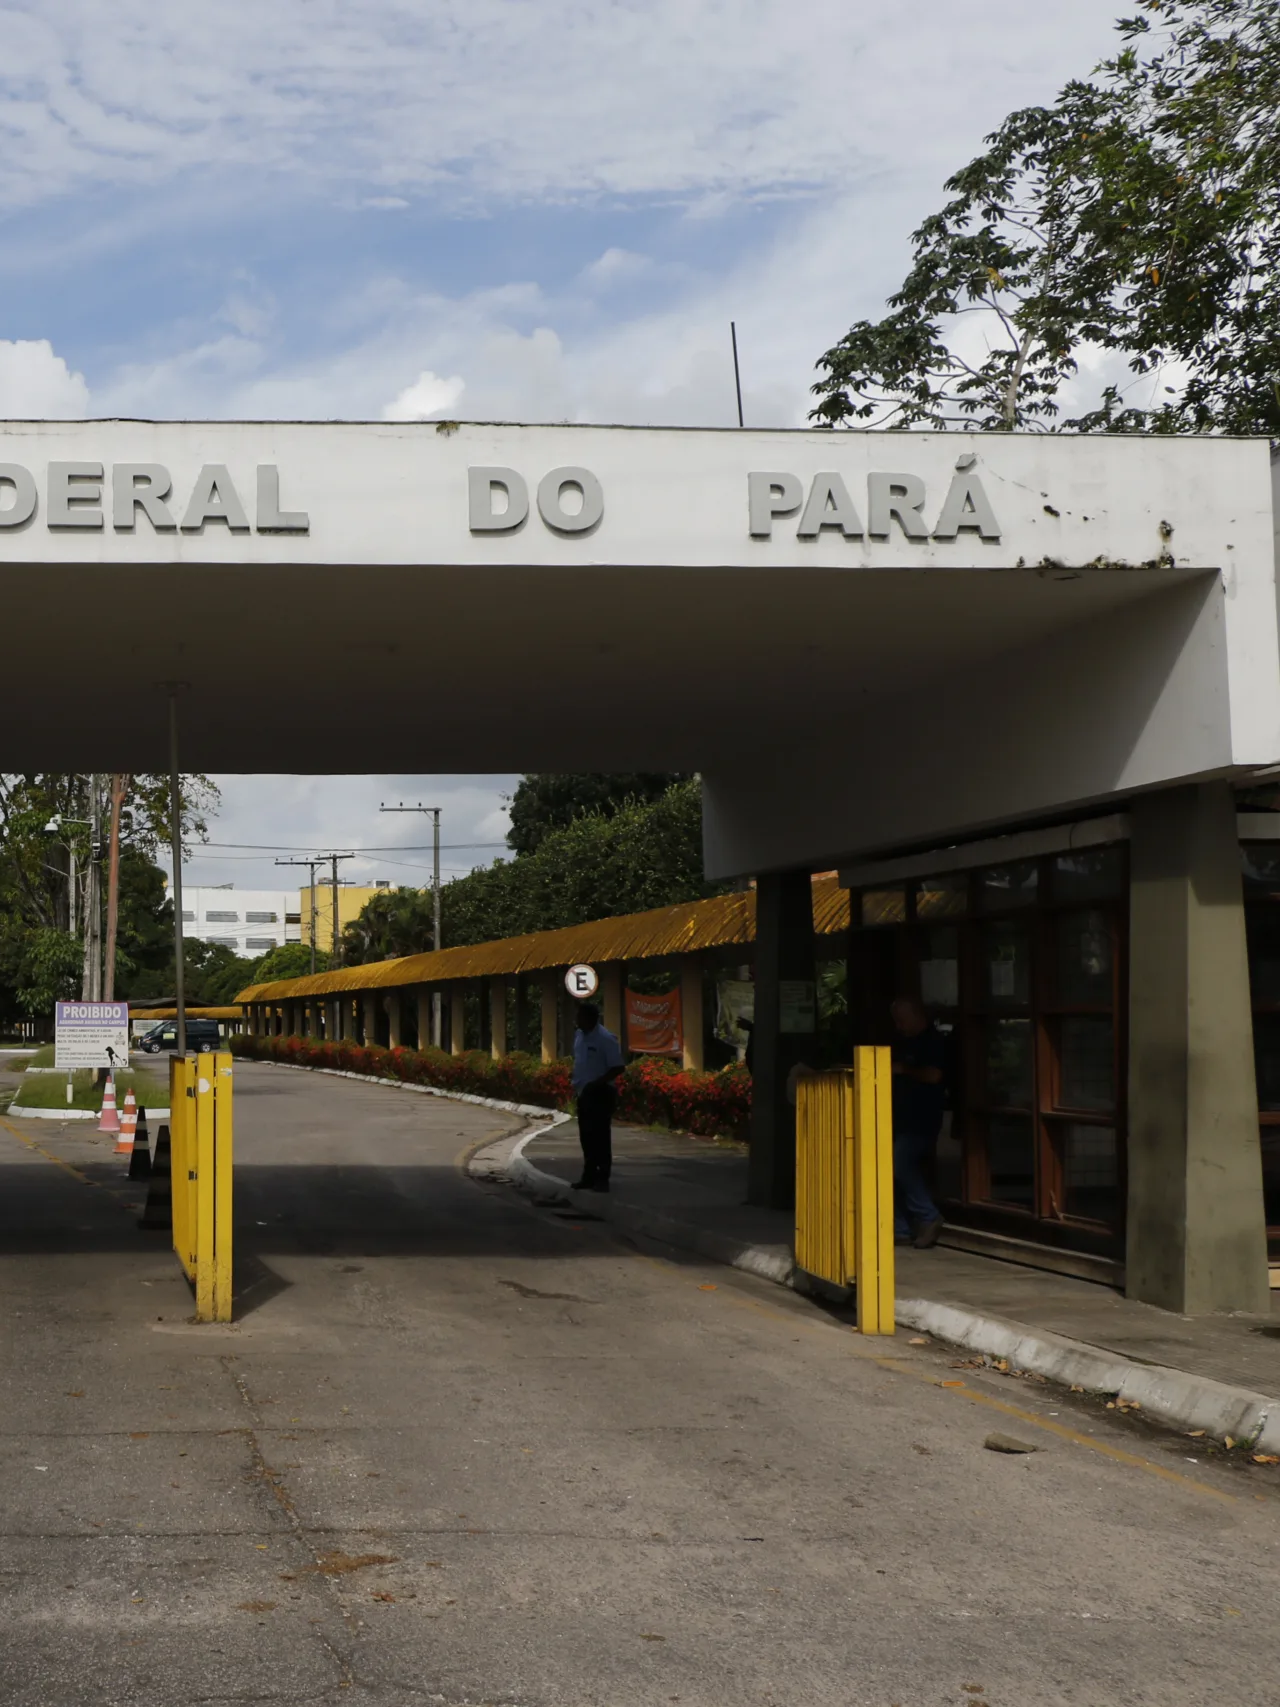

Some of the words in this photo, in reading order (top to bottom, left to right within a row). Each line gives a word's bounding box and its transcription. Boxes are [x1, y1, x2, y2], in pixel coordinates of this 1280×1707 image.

[468, 465, 605, 533] DO
[748, 453, 1002, 539] PARÁ
[576, 972, 588, 991] E
[63, 1006, 122, 1018] PROIBIDO
